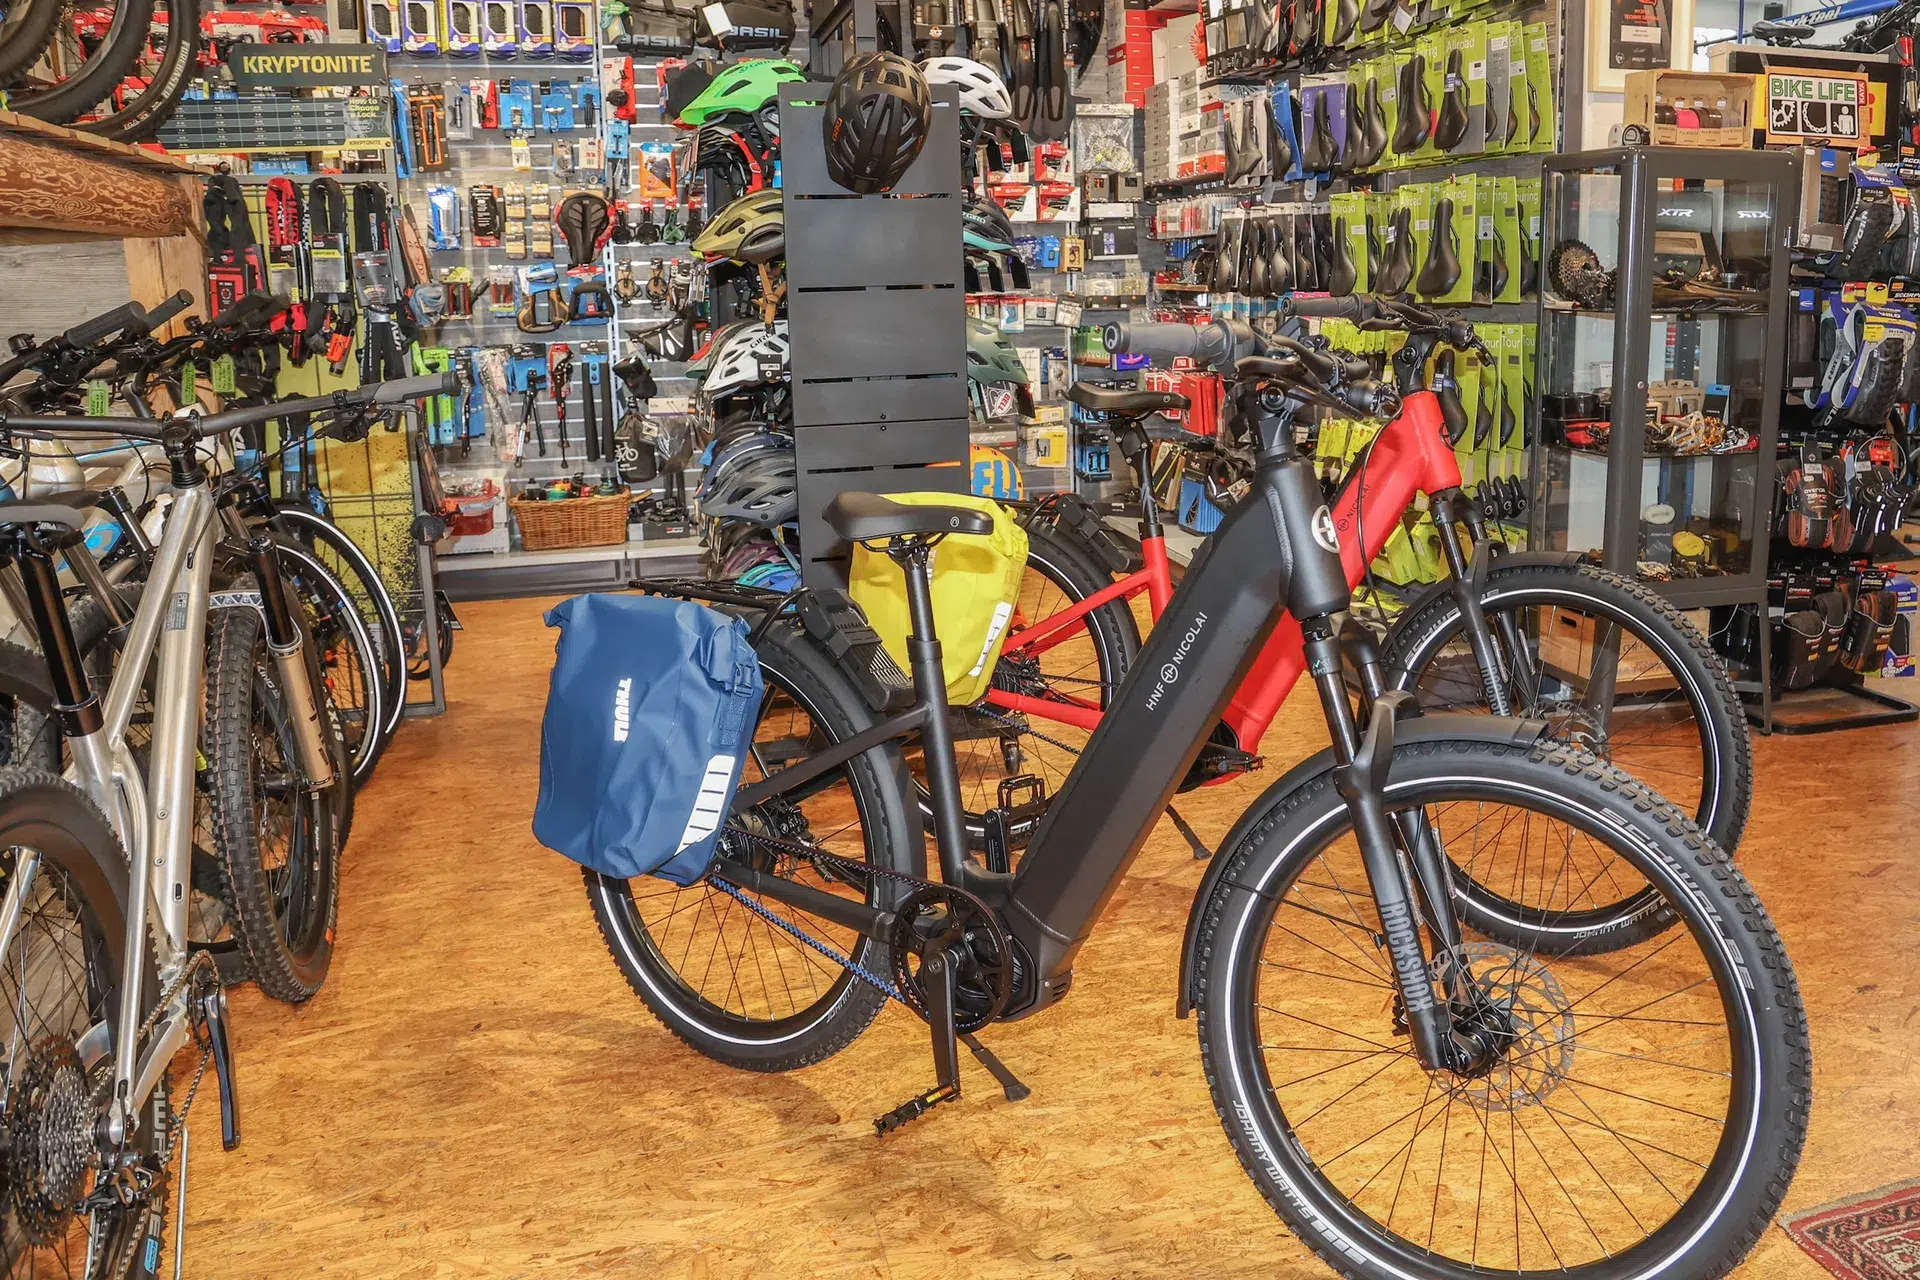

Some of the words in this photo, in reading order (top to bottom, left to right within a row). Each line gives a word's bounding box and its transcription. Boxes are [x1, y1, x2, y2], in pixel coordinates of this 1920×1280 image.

[622, 34, 689, 47] BASIL
[729, 26, 788, 38] BASIL
[1447, 36, 1475, 51] Allroad
[243, 56, 372, 73] KRYPTONITE
[1771, 78, 1813, 99] BIKE
[1818, 81, 1855, 102] LIFE
[1858, 82, 1866, 103] KAYA
[1657, 208, 1694, 217] XTR
[996, 393, 1011, 412] BELL
[1145, 681, 1167, 711] HNF
[1172, 611, 1209, 665] NICOLAI
[613, 677, 632, 743] THULE
[1599, 806, 1756, 991] SCHWALBE
[1620, 903, 1658, 929] WATTS
[1381, 900, 1434, 1012] ROCKSHOX
[1232, 1100, 1271, 1162] JOHNNY
[1265, 1166, 1314, 1219] WATTS
